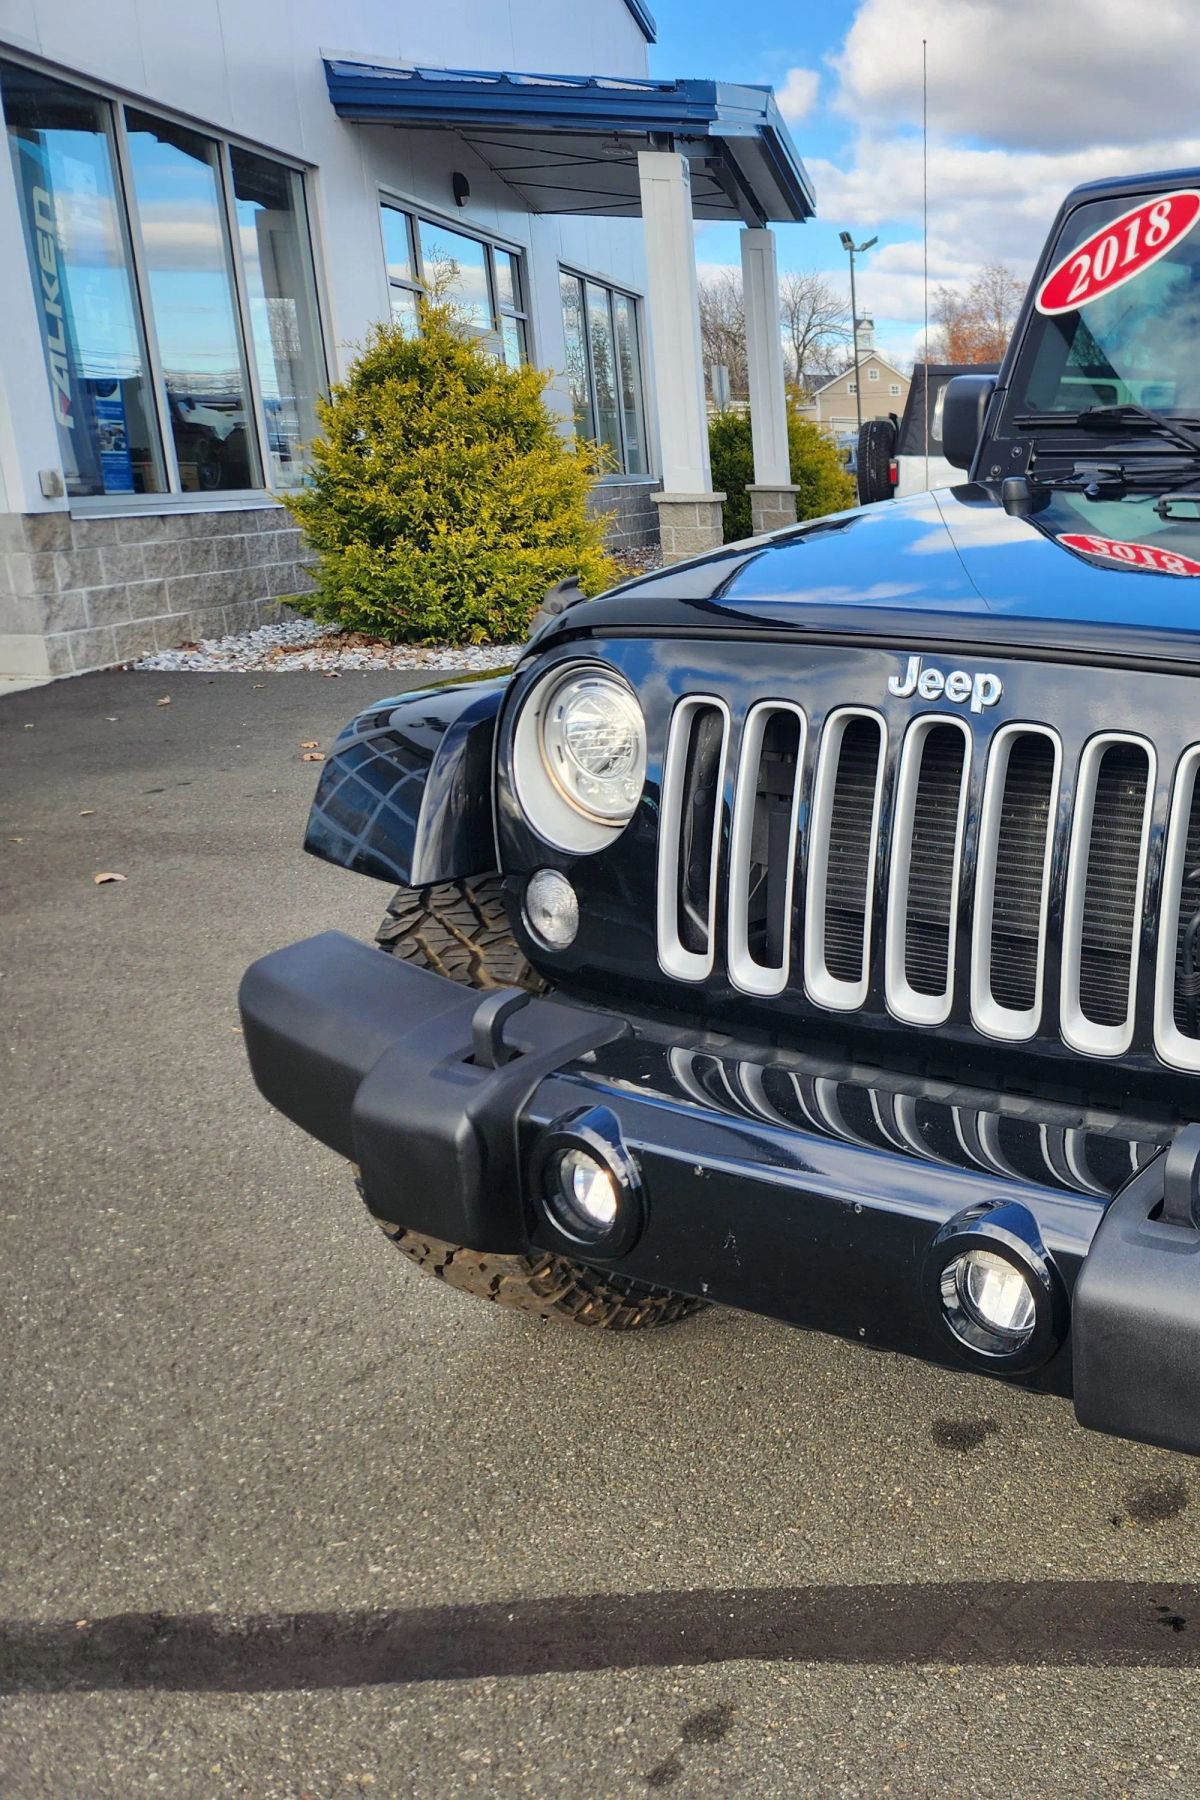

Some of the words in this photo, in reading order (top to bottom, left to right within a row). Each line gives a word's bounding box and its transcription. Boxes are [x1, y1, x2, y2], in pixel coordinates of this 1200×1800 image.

[1066, 200, 1172, 303] 2018
[32, 185, 74, 429] FALKEN
[888, 656, 1004, 714] Jeep
